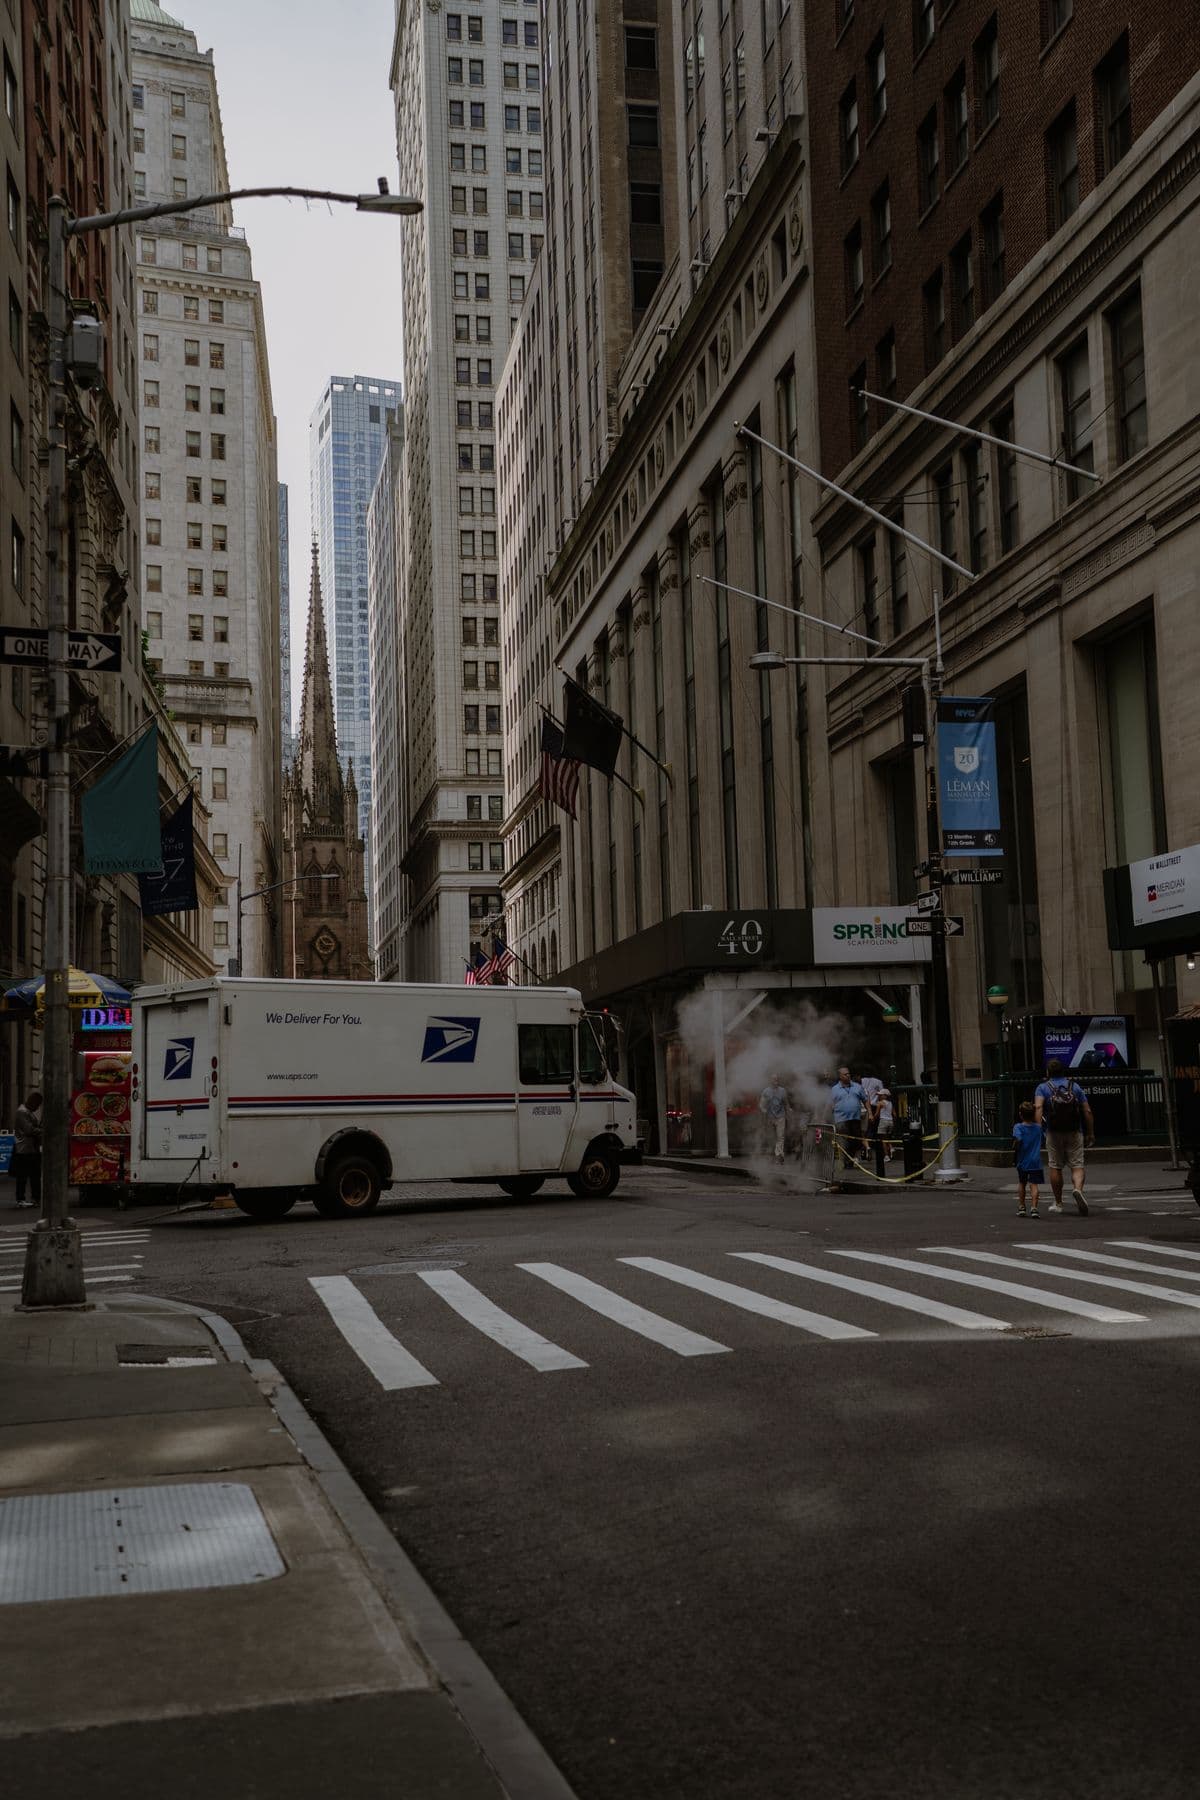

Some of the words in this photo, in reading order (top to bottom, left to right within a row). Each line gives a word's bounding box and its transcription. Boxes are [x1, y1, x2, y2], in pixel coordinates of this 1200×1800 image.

[14, 639, 48, 655] ONE
[68, 643, 102, 660] WAY
[959, 753, 975, 765] 20
[959, 872, 995, 882] WILLIAM
[1156, 878, 1185, 892] MERIDIAN
[911, 922, 928, 931] ONE
[717, 919, 763, 955] 40
[266, 1012, 283, 1024] We
[284, 1012, 321, 1024] Deliver
[323, 1013, 341, 1025] For
[342, 1013, 362, 1025] You.
[1045, 1033, 1060, 1042] ON
[1060, 1033, 1072, 1042] US
[266, 1072, 319, 1082] www.usps.com
[1092, 1086, 1121, 1095] Station
